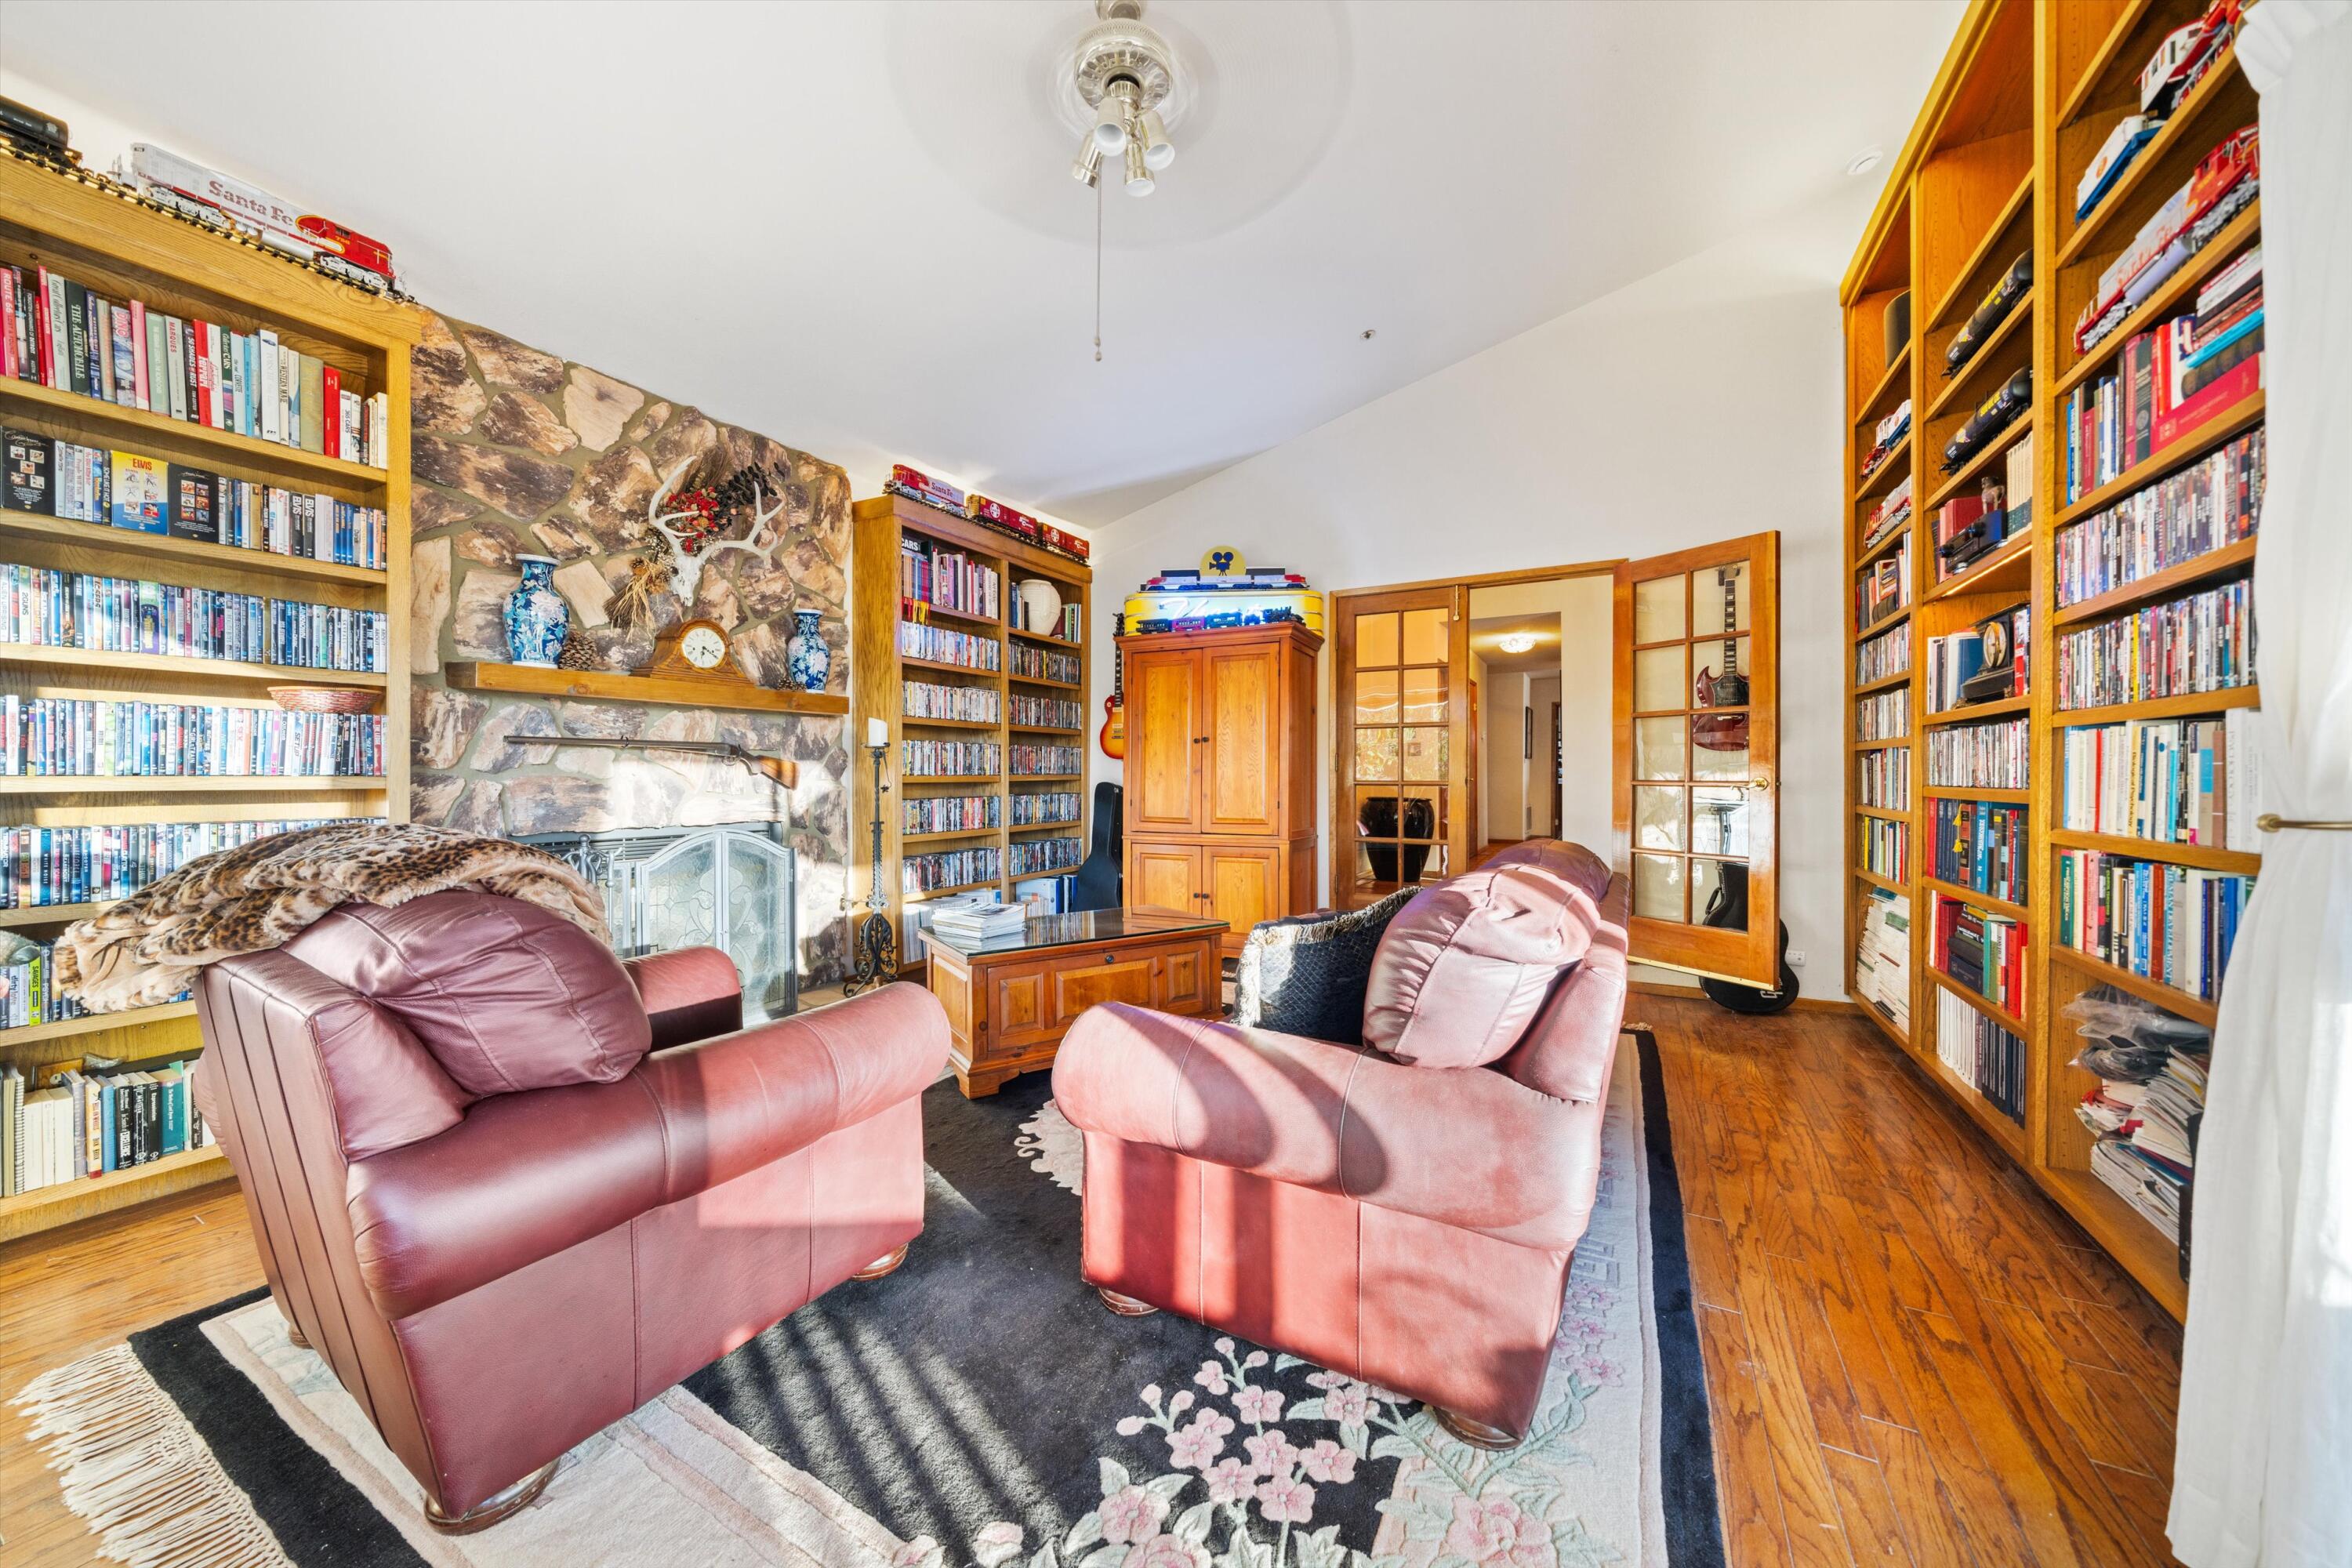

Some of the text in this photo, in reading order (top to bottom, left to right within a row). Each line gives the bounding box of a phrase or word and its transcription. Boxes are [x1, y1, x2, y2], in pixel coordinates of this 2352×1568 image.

[209, 180, 294, 227] Santa Fe
[4, 273, 13, 300] ROUTE
[5, 302, 13, 314] 66
[114, 312, 129, 338] DINO
[71, 304, 85, 379] THE AUTOMOBILE
[169, 321, 177, 353] MARQUES
[234, 375, 242, 393] CORVETTE
[279, 365, 288, 388] WESTERN
[132, 458, 152, 471] ELVIS
[931, 482, 947, 495] Santa
[292, 495, 302, 515] ELVIS
[305, 498, 314, 517] ELVIS
[10, 975, 19, 991] dirty
[120, 1131, 131, 1158] EXCELLENCE
